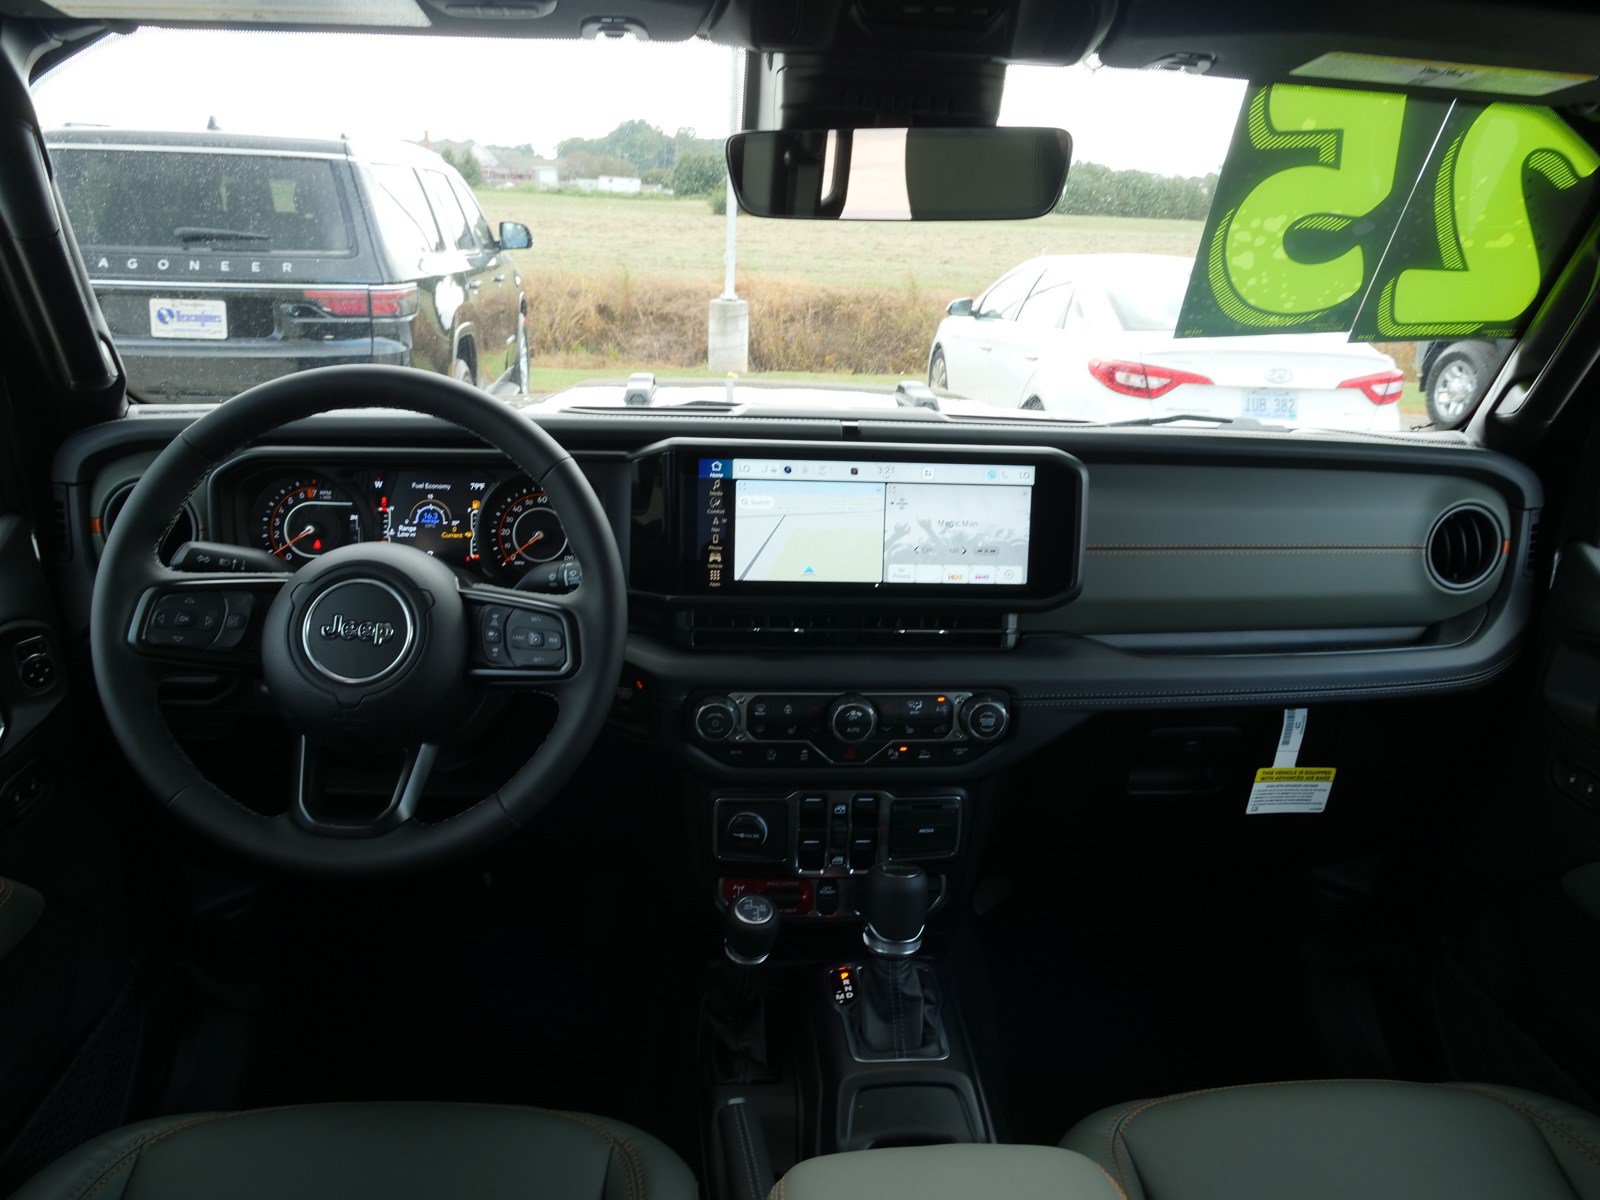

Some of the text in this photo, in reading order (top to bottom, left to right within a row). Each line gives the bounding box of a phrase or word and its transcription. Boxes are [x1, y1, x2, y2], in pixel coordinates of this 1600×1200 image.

[97, 256, 293, 273] AGONEER
[374, 480, 383, 489] W
[411, 482, 452, 491] Fuel Economy
[537, 496, 548, 504] 60
[398, 524, 417, 533] Range
[937, 520, 978, 529] Magic Man
[501, 528, 511, 536] 20
[321, 614, 394, 645] Jeep
